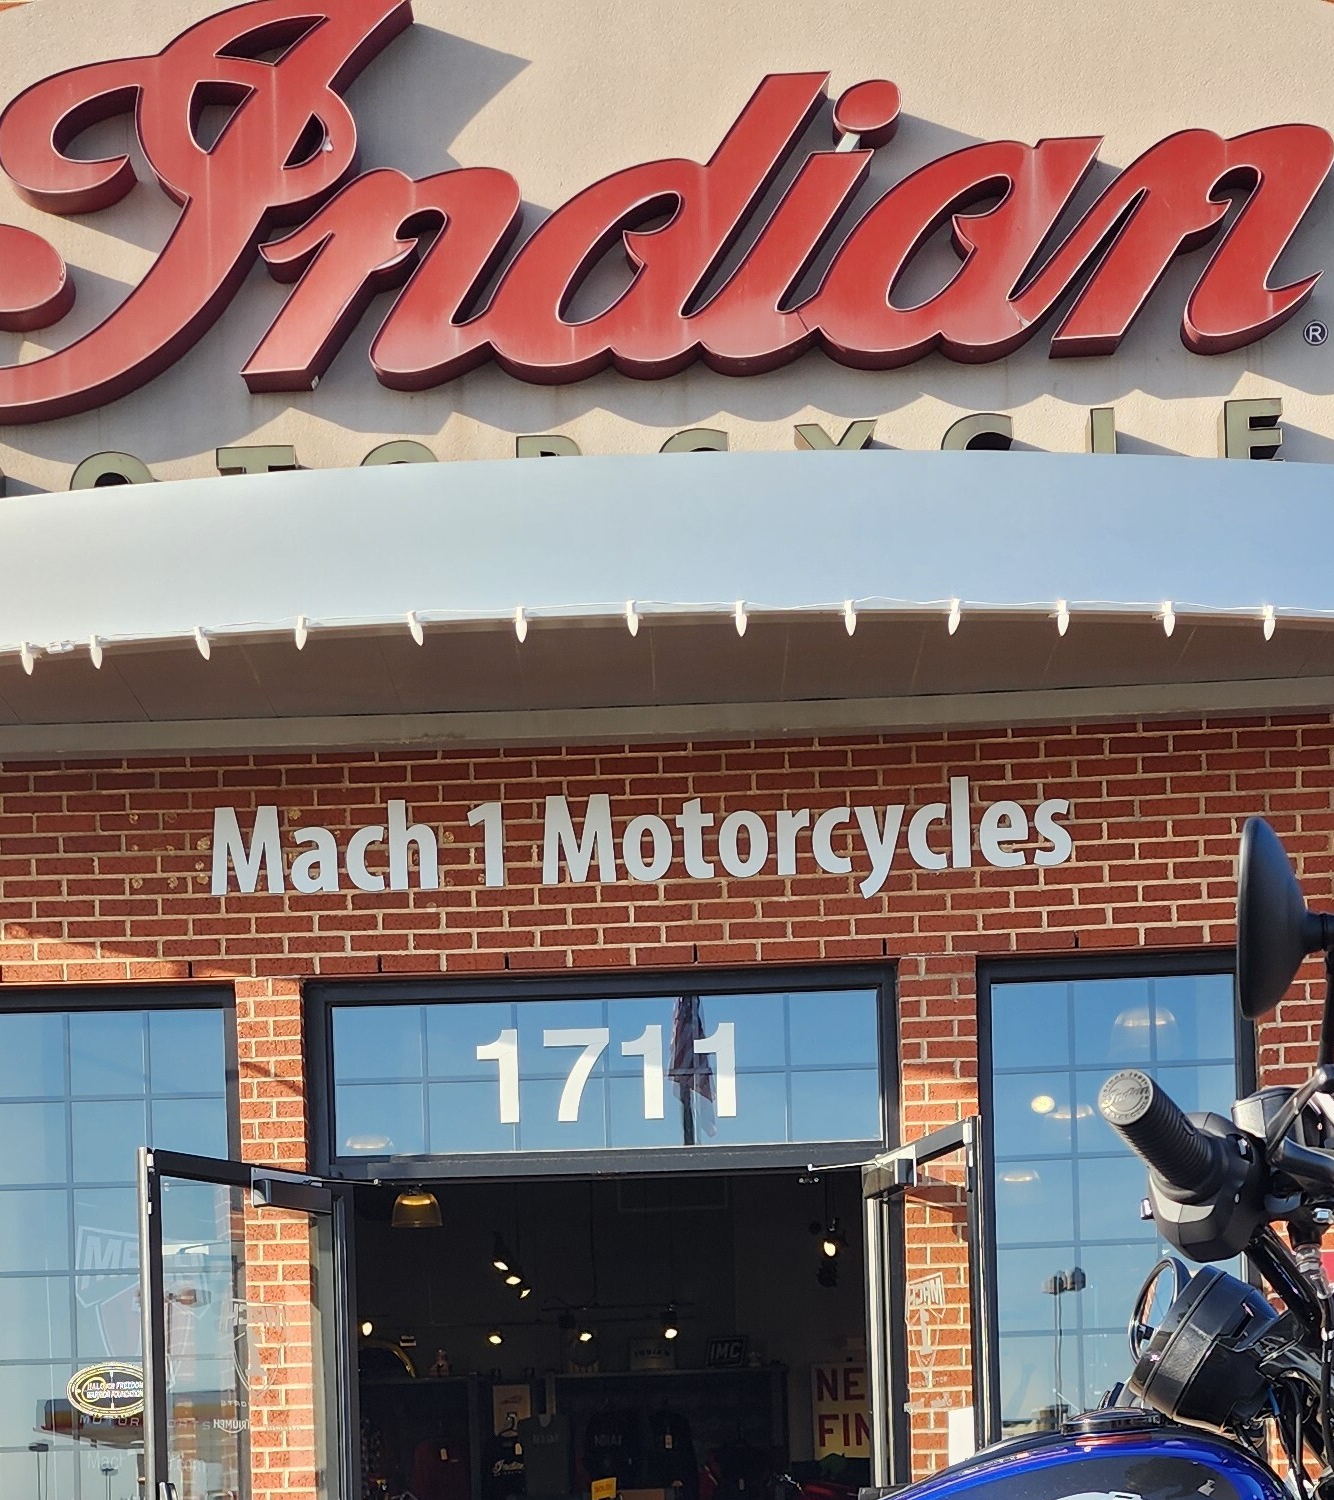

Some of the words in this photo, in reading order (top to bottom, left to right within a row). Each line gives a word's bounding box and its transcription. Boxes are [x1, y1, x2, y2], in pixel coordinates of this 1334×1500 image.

[210, 799, 440, 897] Mach
[468, 802, 505, 888] 1
[543, 776, 1073, 899] Motorcycles
[476, 1022, 737, 1124] 1711
[818, 1368, 865, 1400] NE
[818, 1413, 870, 1447] FIN
